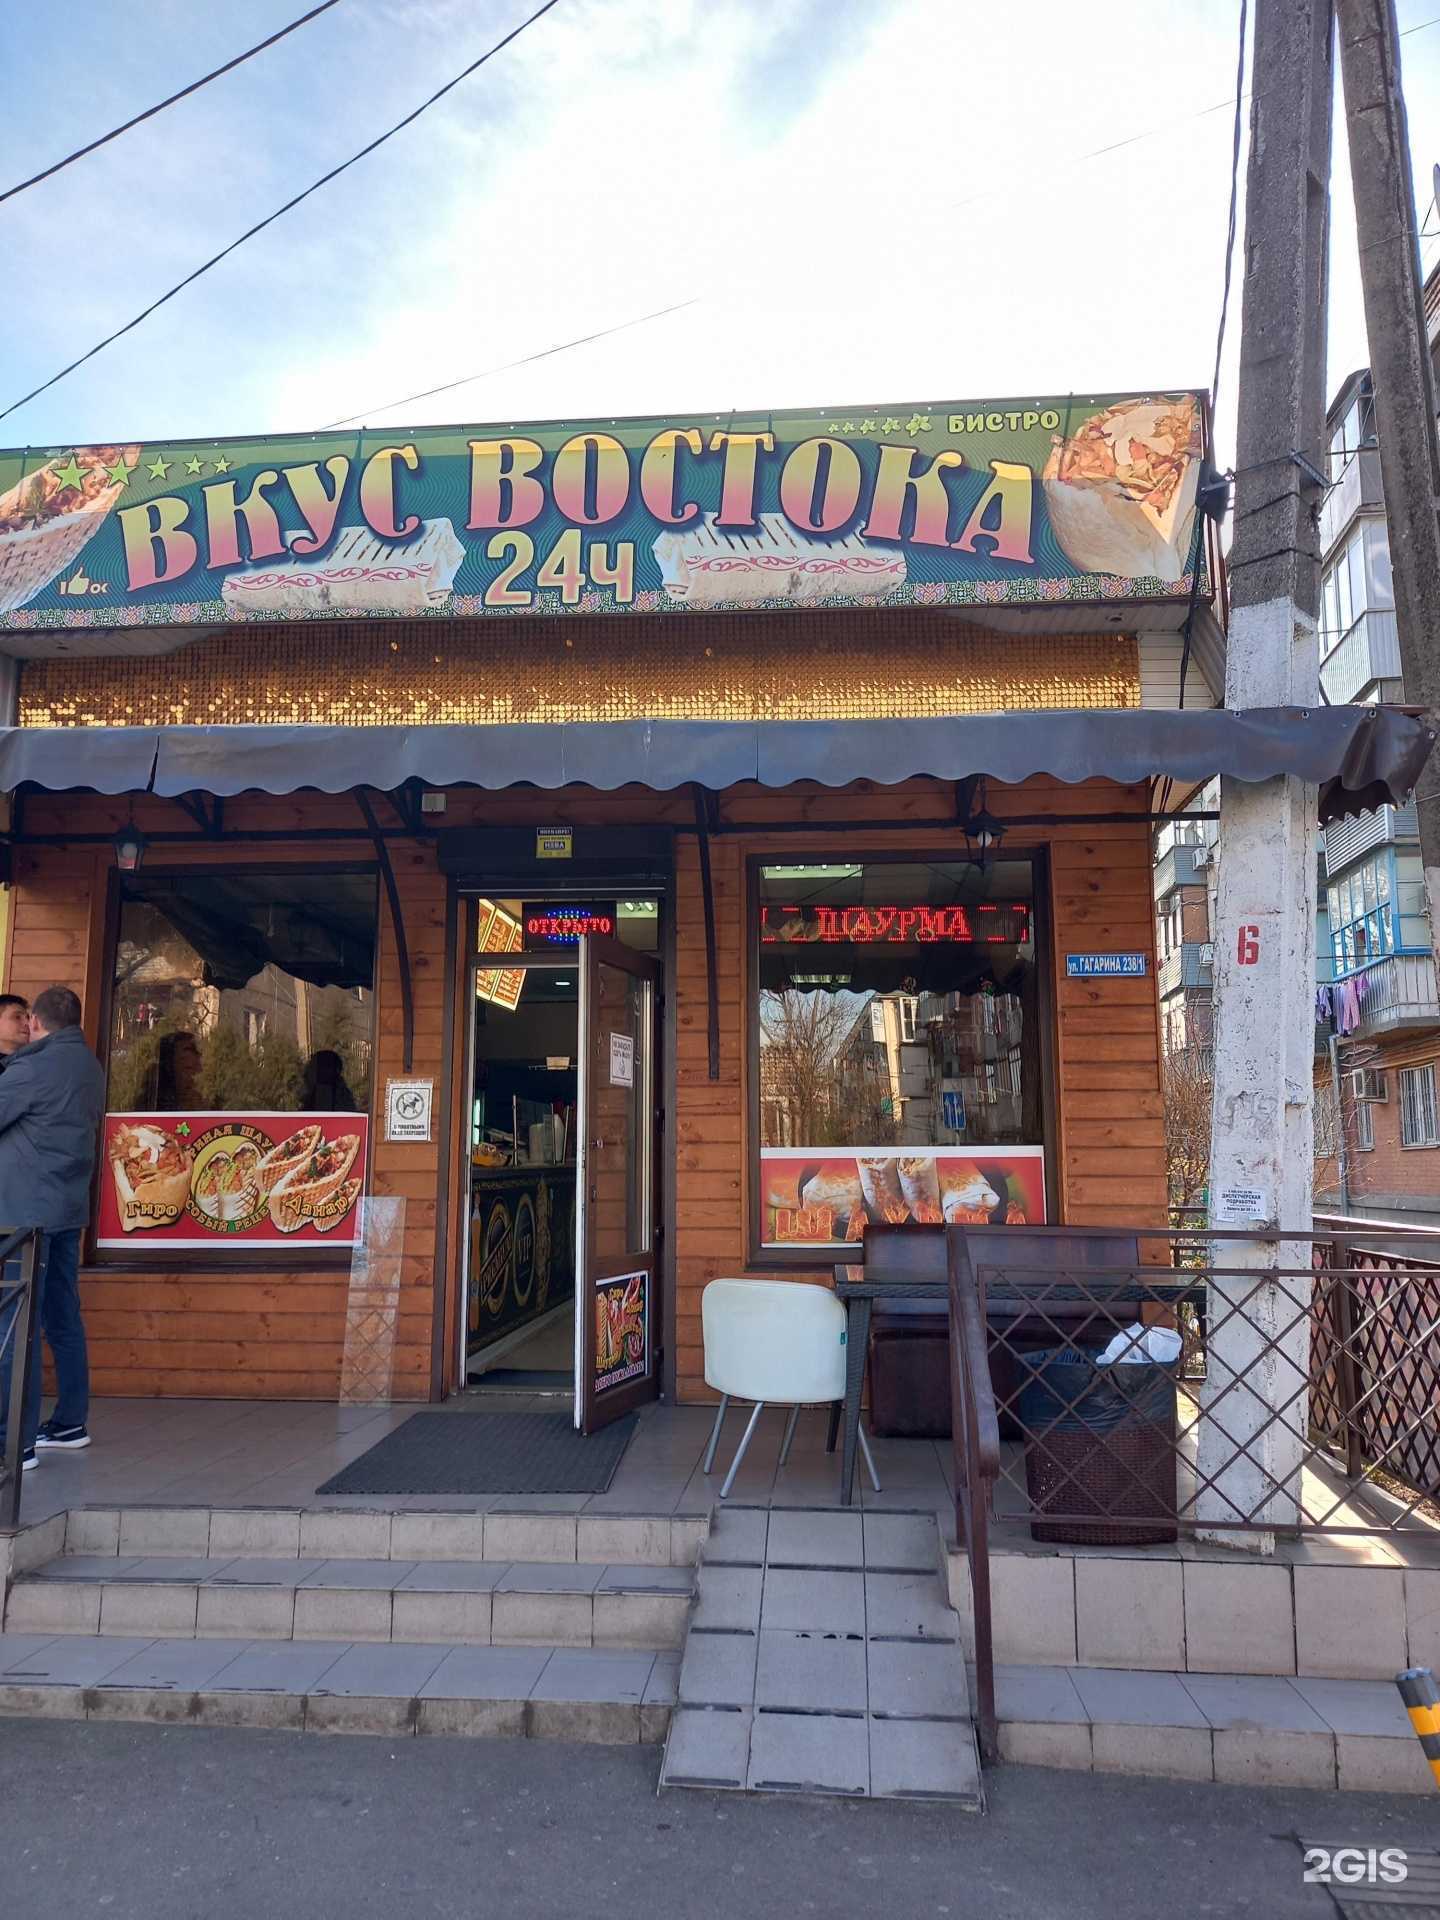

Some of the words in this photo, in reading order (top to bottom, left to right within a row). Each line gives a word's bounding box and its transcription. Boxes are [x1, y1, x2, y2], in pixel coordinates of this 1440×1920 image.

[947, 410, 1060, 434] БИСТРО
[117, 443, 421, 593] ВКУС
[465, 427, 1036, 565] ВОСТОКА
[528, 917, 611, 934] ОТКРЫТО
[817, 910, 971, 937] ШАУРМА
[1237, 925, 1260, 965] 6
[1068, 962, 1079, 975] ул.
[1079, 956, 1121, 973] ГАГАРИНА
[127, 1201, 178, 1217] Гиро
[185, 1198, 229, 1233] СОБЫЙ
